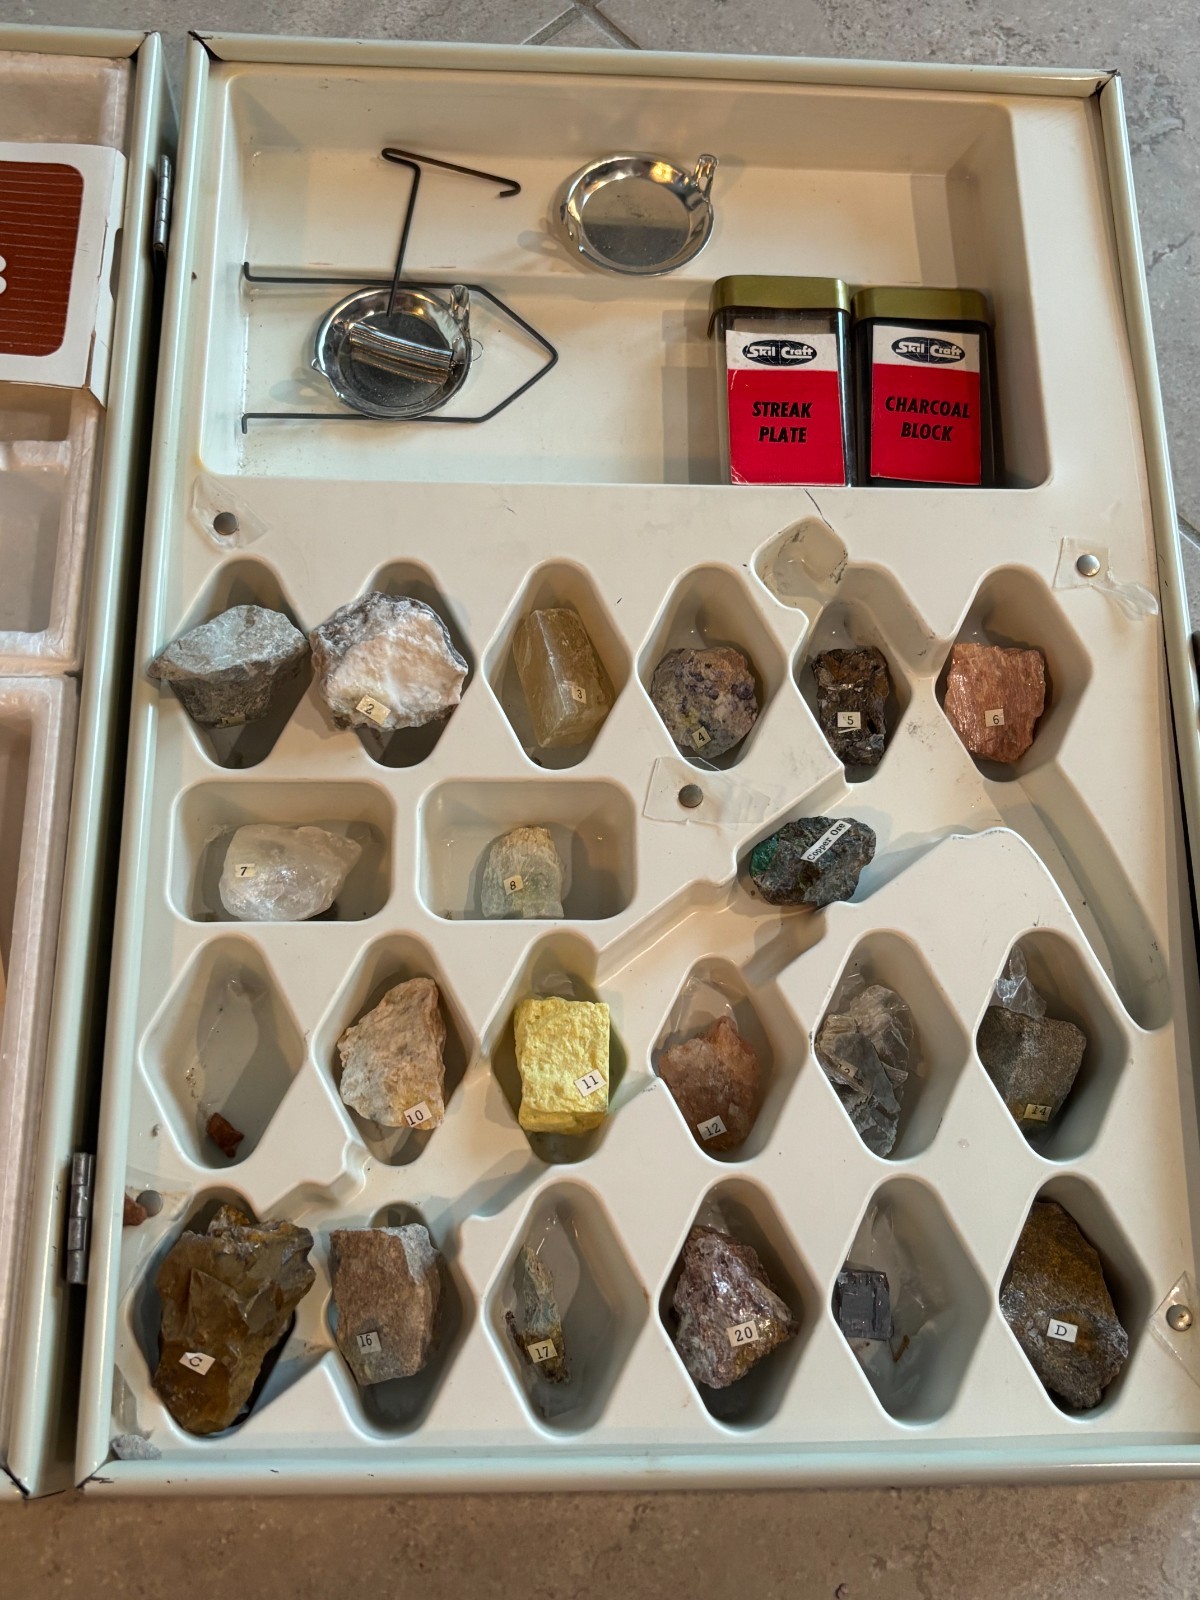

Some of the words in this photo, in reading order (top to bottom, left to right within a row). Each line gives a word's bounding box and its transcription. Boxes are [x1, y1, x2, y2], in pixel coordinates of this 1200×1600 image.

[745, 344, 775, 357] Skil
[781, 344, 814, 359] Craft
[895, 341, 925, 355] Skil
[930, 344, 962, 360] Craft
[752, 401, 813, 419] STREAK
[885, 396, 970, 419] CHARCOAL
[758, 426, 807, 443] PLATE
[900, 421, 953, 441] BLOCK
[577, 689, 583, 699] 3
[364, 703, 375, 715] 2
[847, 715, 854, 725] 5
[992, 714, 1000, 725] 6
[698, 732, 705, 742] 4
[807, 836, 832, 862] Copper
[830, 822, 847, 837] Ore
[240, 866, 248, 876] 7
[509, 880, 517, 891] 8
[581, 1075, 599, 1090] 11
[406, 1109, 424, 1126] 10
[1031, 1105, 1047, 1116] 14
[704, 1122, 721, 1137] 12
[734, 1326, 753, 1342] 20
[1054, 1324, 1068, 1337] D
[359, 1334, 373, 1348] 16
[534, 1346, 549, 1360] 17
[189, 1356, 203, 1367] C
